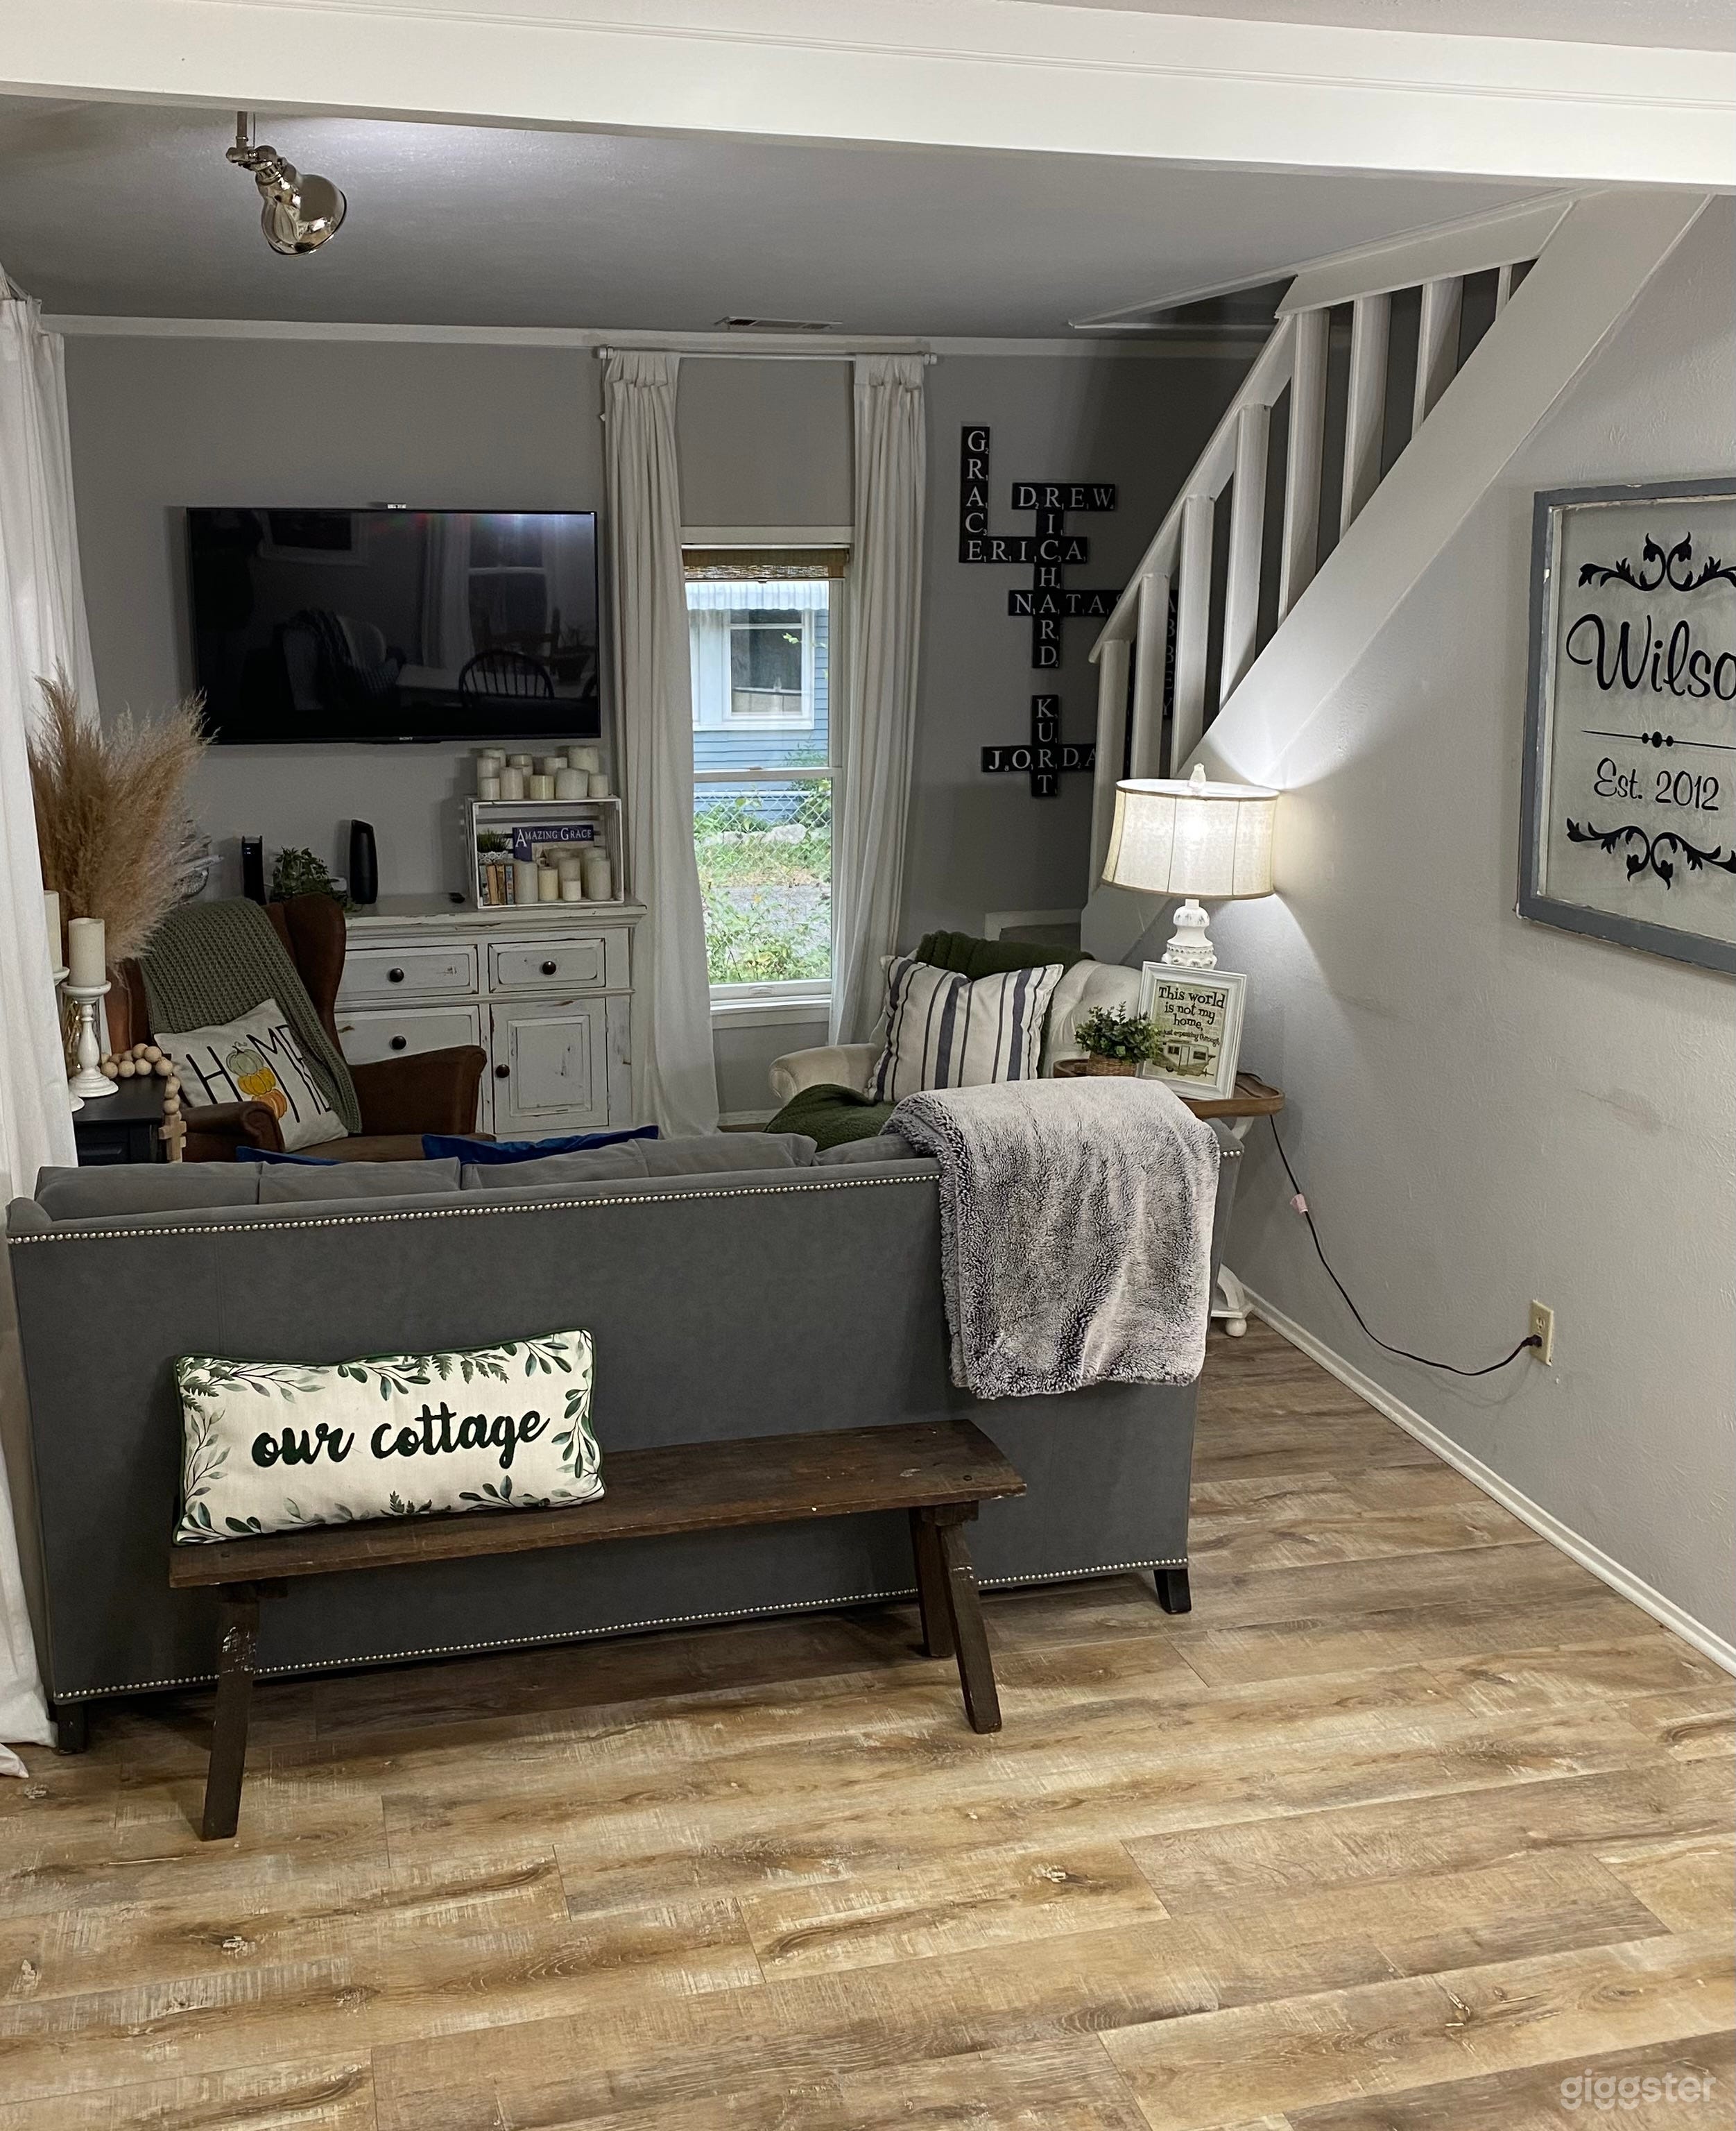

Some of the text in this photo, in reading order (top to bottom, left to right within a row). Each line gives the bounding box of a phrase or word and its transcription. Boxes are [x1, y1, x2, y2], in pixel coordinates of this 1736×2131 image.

[965, 430, 988, 562] GRACE
[1018, 486, 1114, 508] DREW
[967, 539, 1084, 561] ERICA
[1039, 487, 1060, 665] RICHARD
[1036, 698, 1057, 795] KURT
[1594, 757, 1719, 811] Est. 2012
[515, 827, 592, 848] AMAZING GRACE
[1158, 985, 1226, 1009] This world
[1164, 1002, 1216, 1025] is not my
[1173, 1013, 1203, 1031] home,
[251, 1401, 550, 1469] our cottage
